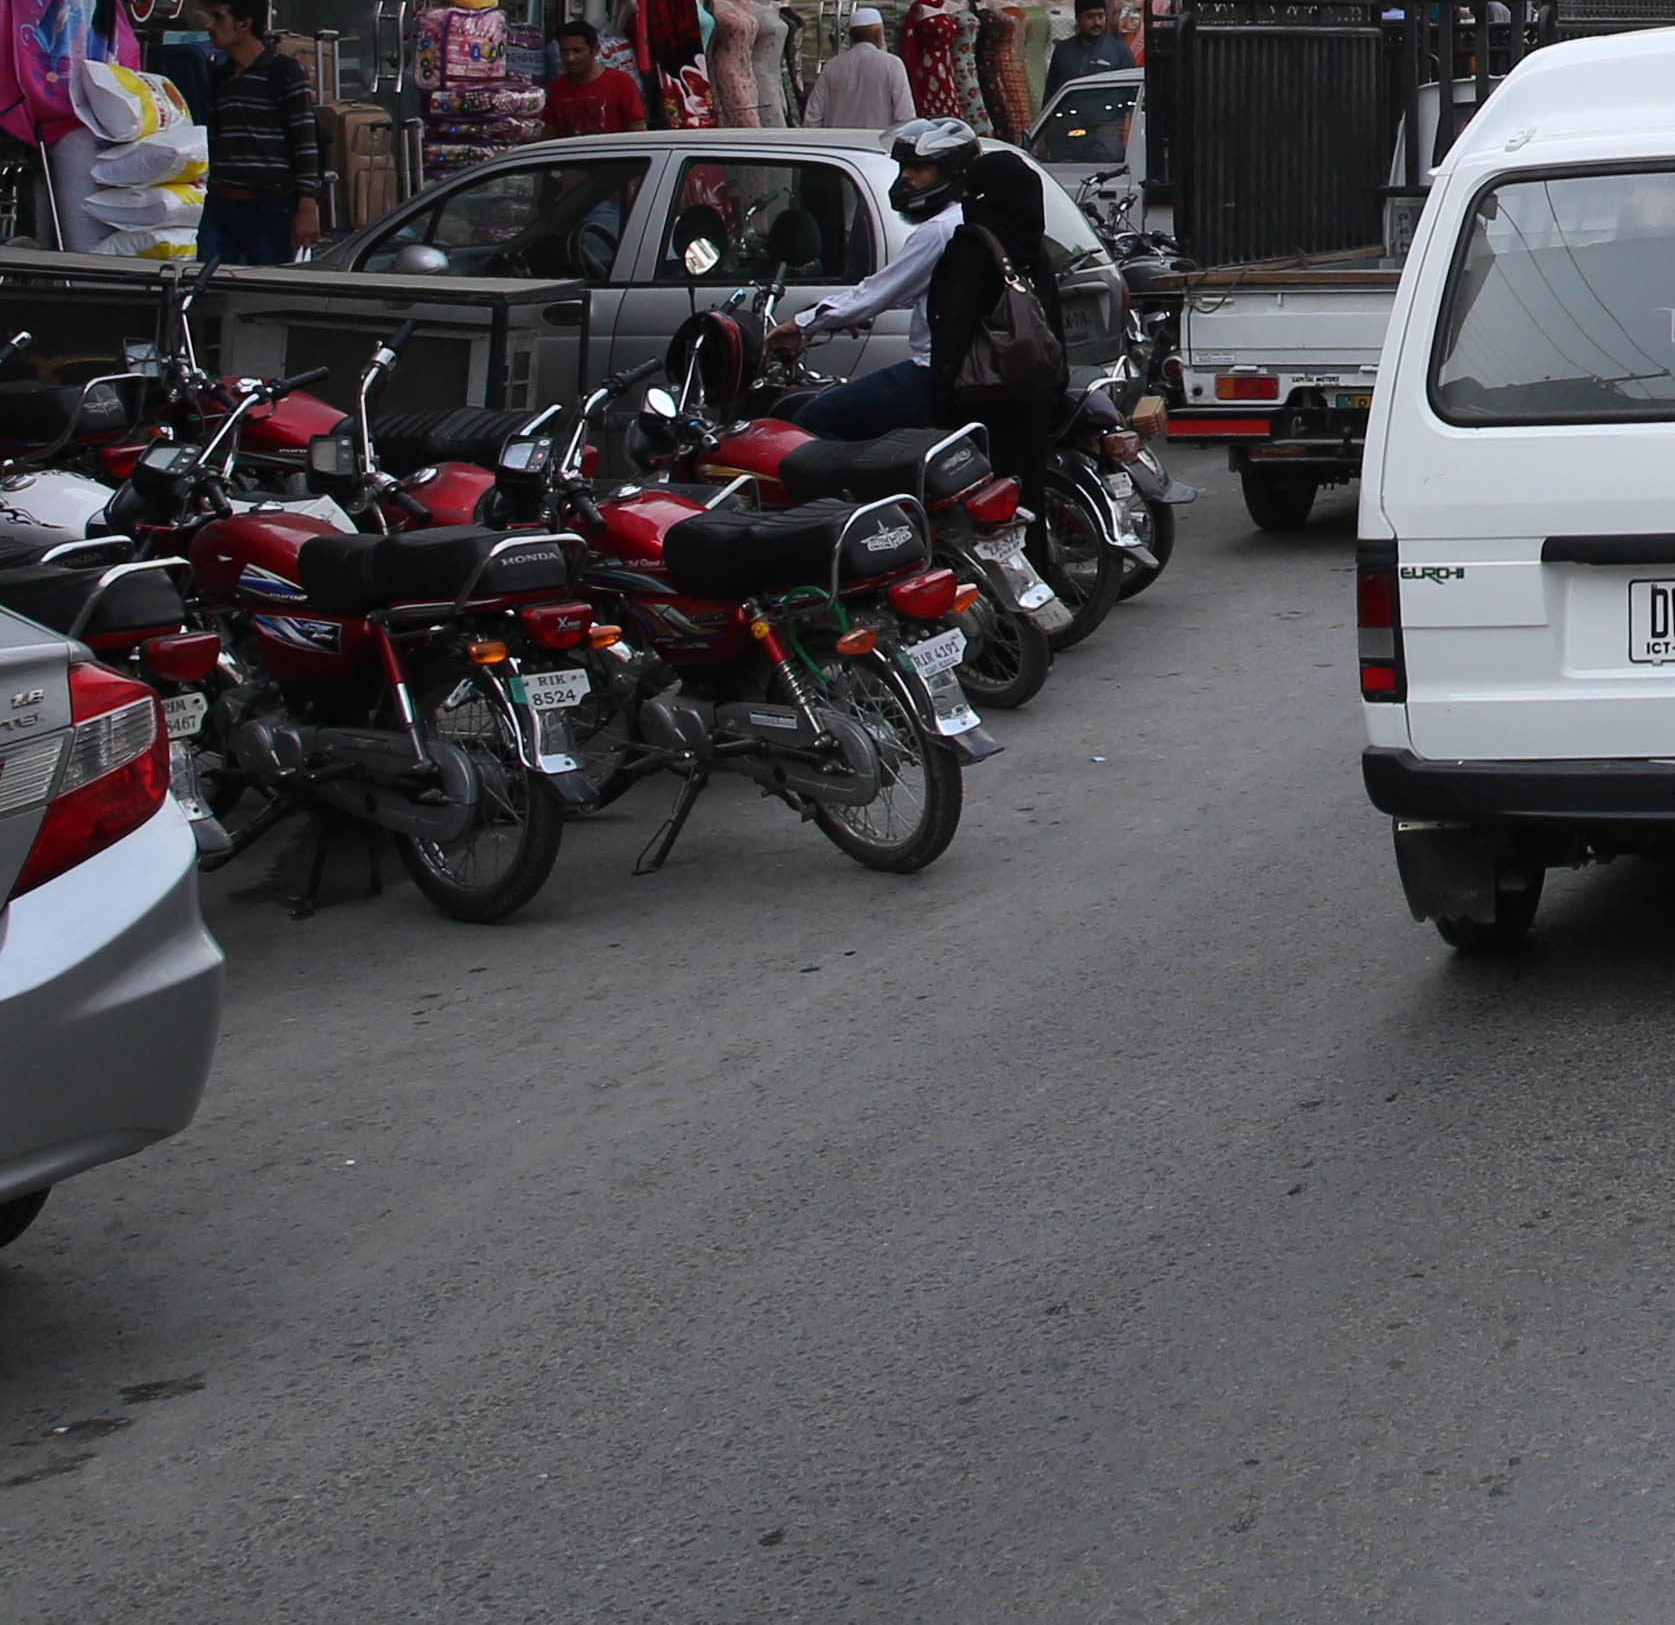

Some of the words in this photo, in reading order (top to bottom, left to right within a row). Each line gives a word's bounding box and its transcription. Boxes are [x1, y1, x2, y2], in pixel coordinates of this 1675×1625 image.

[501, 551, 560, 567] HONDA
[537, 675, 565, 687] RIK
[531, 690, 577, 706] 8524
